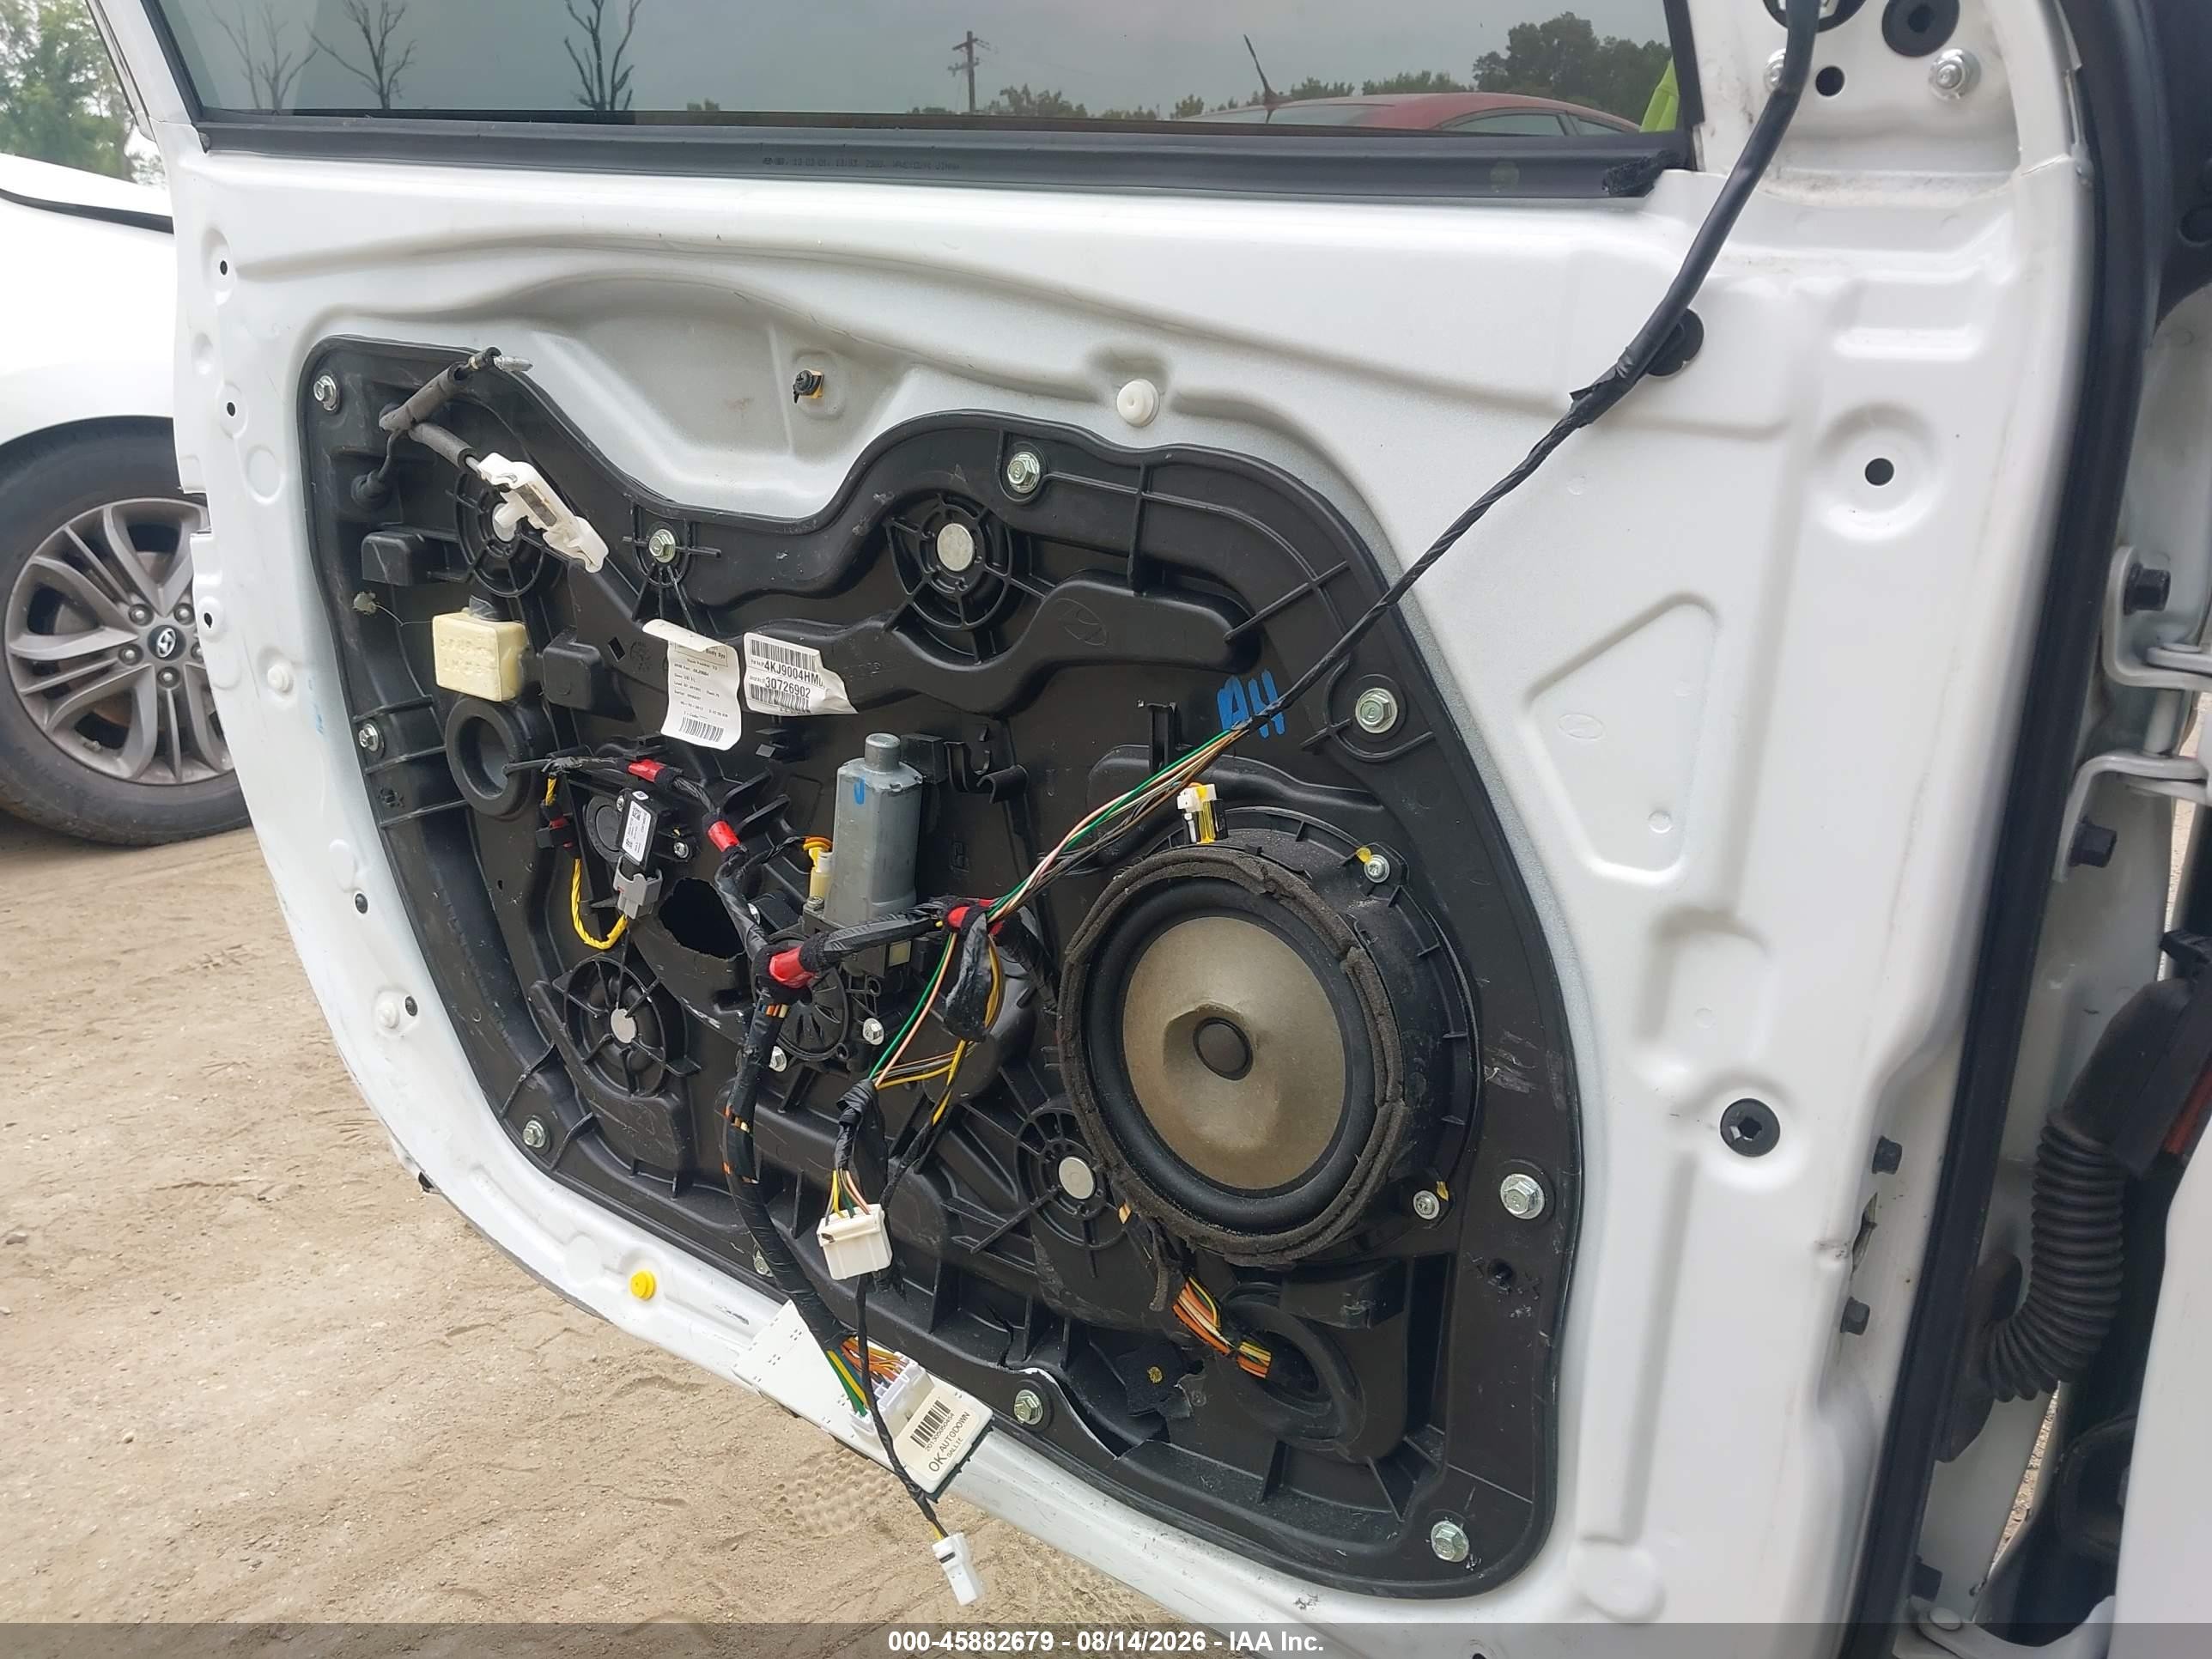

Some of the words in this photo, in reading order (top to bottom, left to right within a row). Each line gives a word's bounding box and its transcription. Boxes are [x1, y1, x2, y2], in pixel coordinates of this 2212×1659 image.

[765, 676, 811, 699] 30726902
[939, 1411, 970, 1452] AUTODOWN
[928, 1452, 948, 1472] OK
